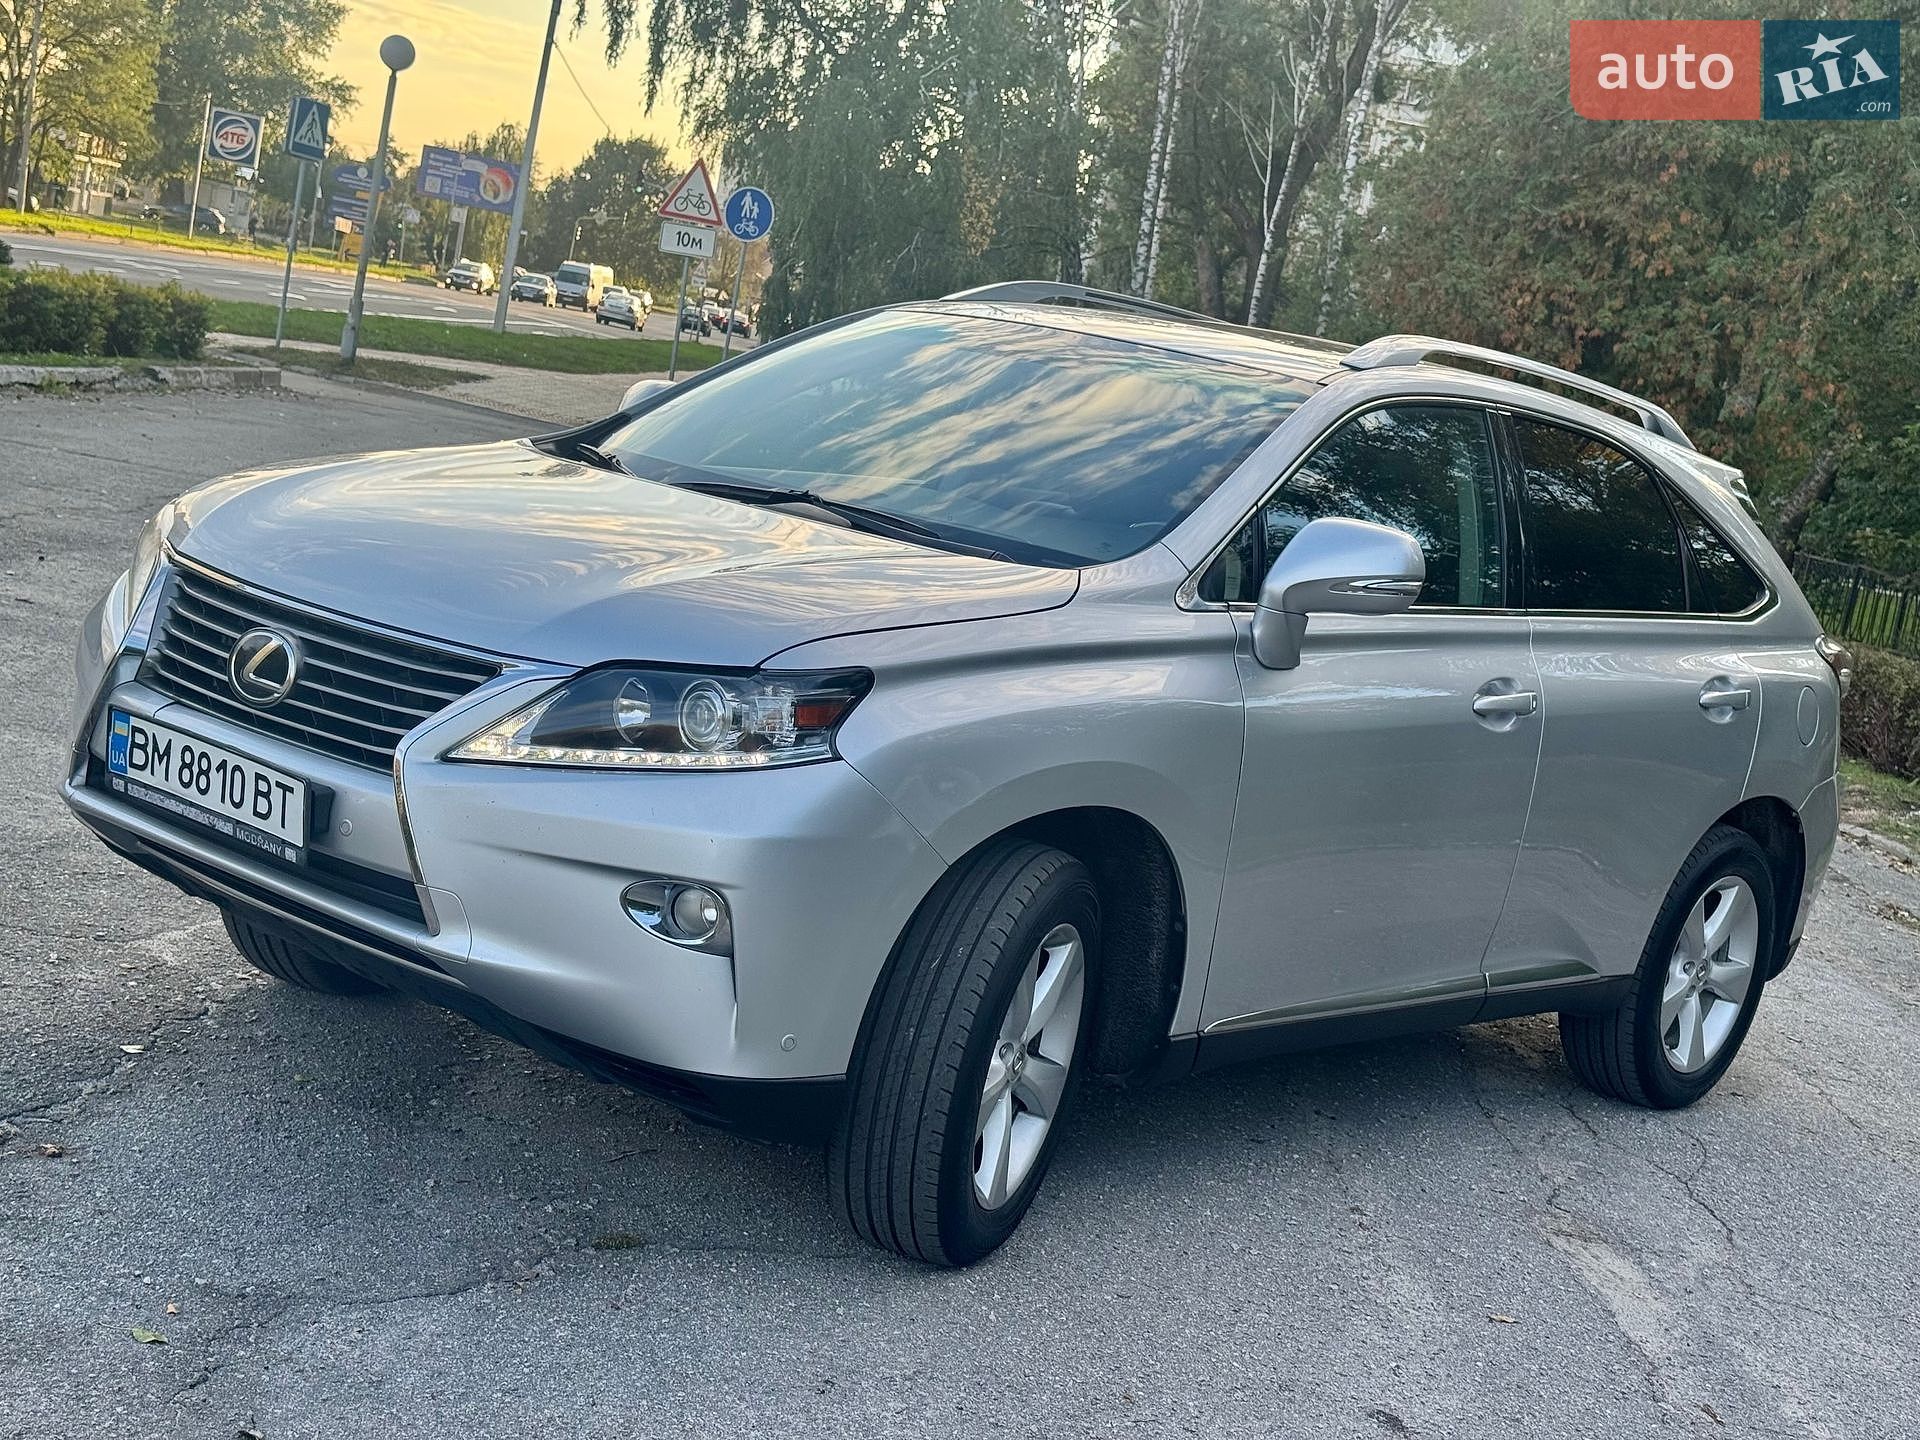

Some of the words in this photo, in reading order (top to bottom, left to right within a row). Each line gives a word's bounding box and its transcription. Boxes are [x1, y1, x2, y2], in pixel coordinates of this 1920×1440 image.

[112, 750, 126, 767] UA
[128, 725, 172, 782] BM
[178, 745, 246, 809] 8810
[252, 772, 294, 829] BT
